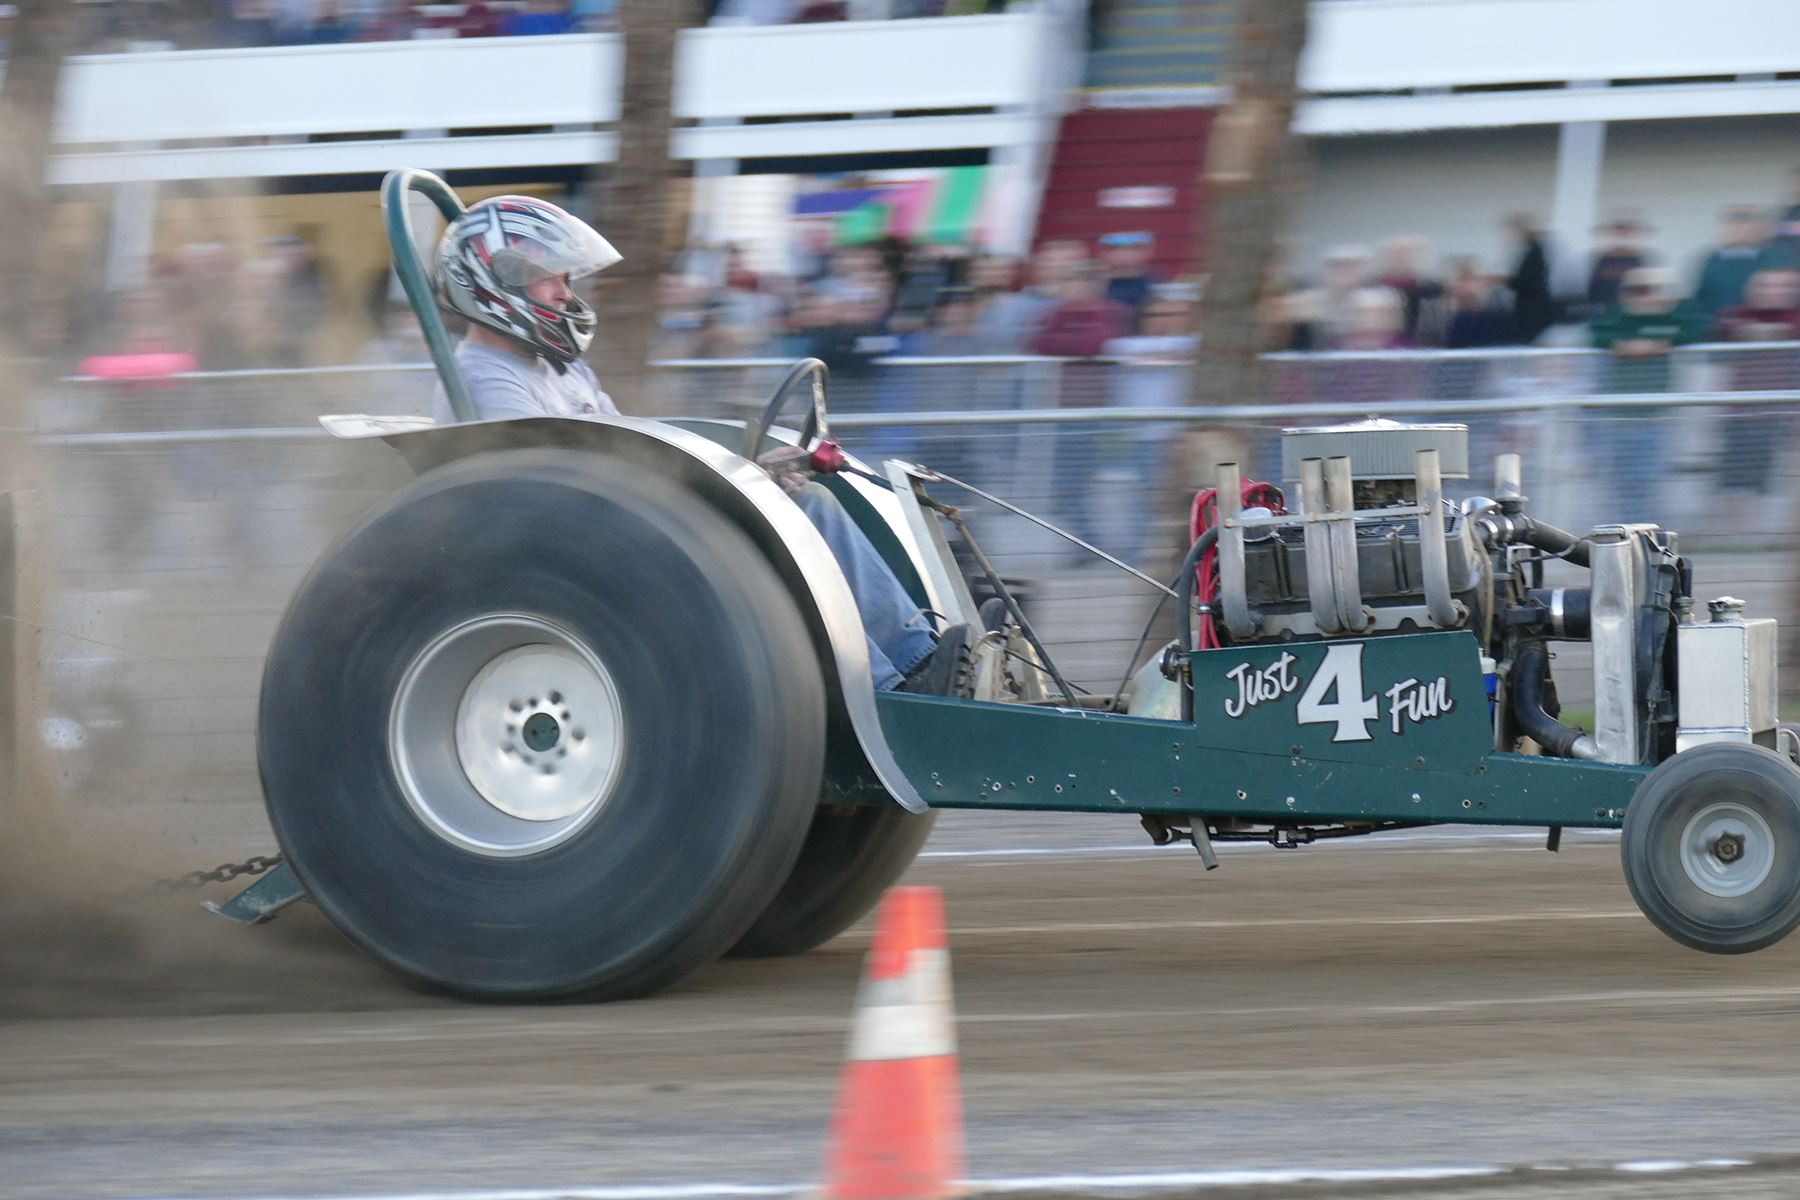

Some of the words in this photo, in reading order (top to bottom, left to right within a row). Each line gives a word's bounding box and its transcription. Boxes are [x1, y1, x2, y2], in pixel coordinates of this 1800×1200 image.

[1224, 651, 1298, 718] Just
[1297, 643, 1379, 742] 4
[1385, 677, 1454, 734] Fun
